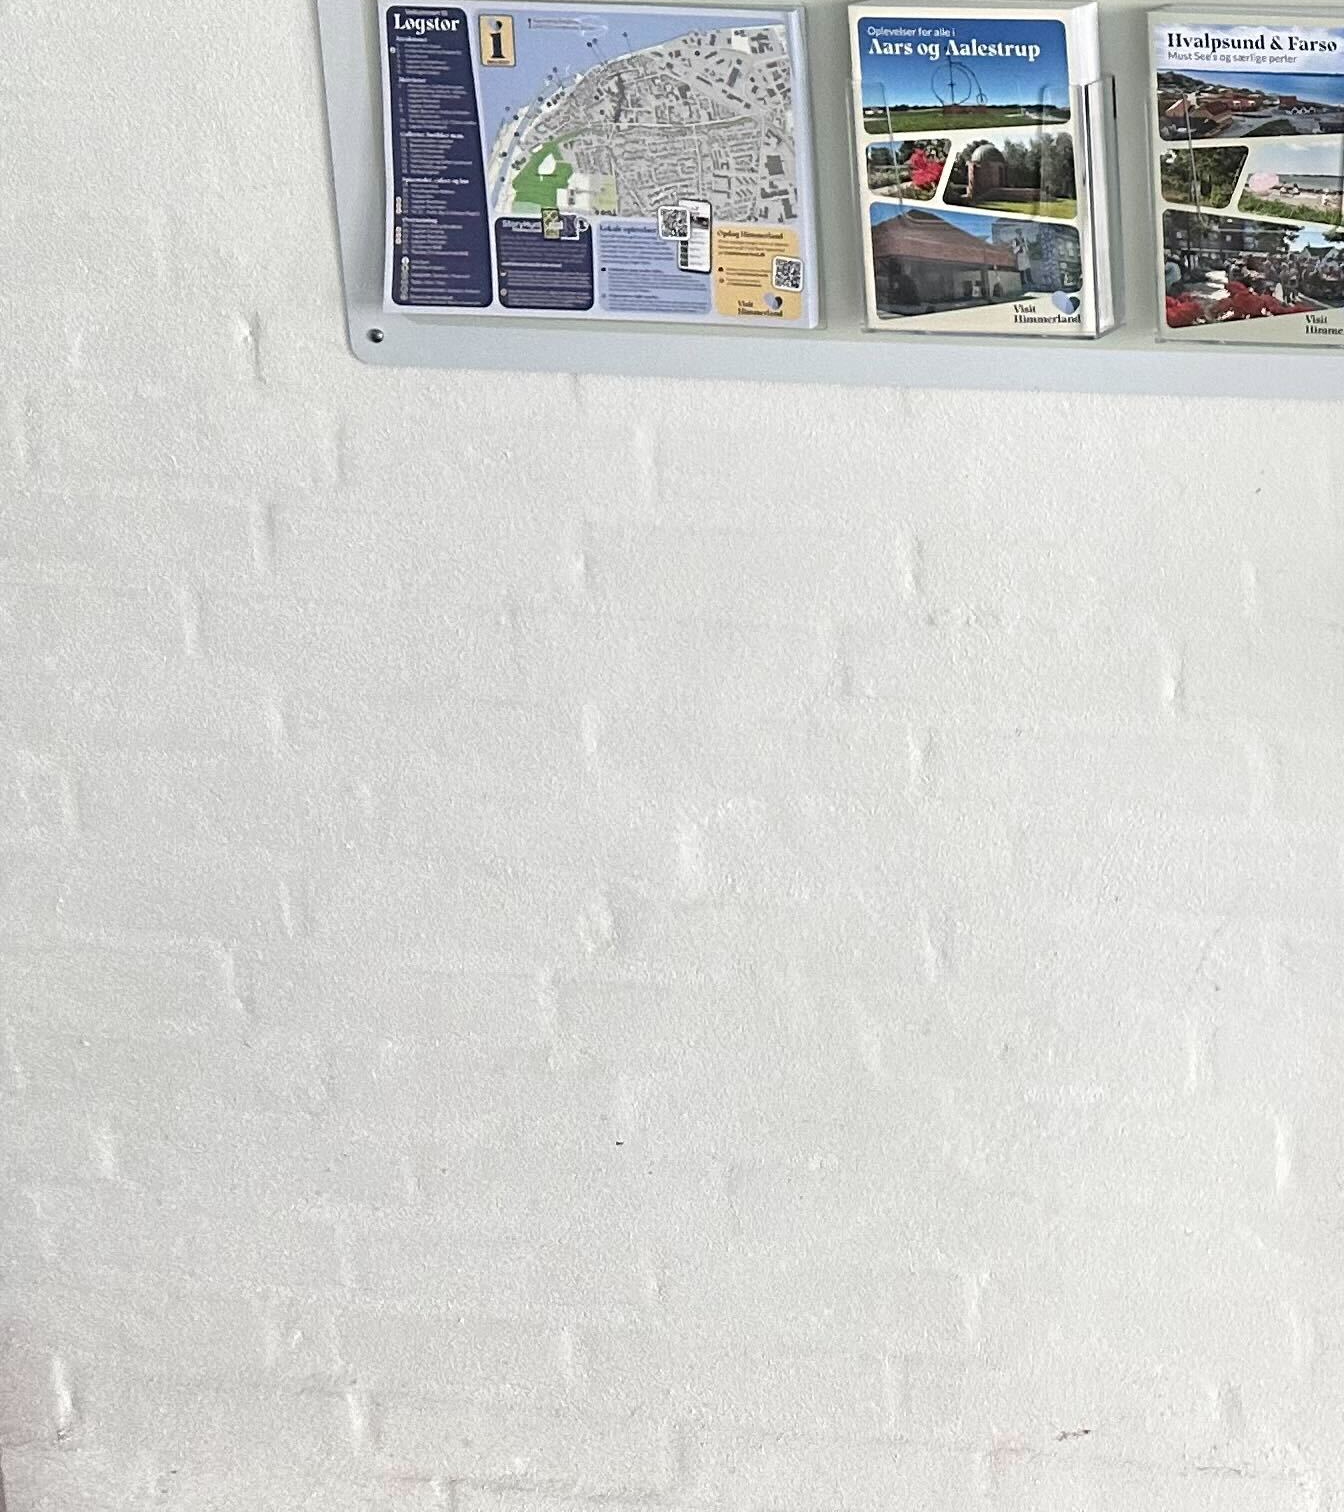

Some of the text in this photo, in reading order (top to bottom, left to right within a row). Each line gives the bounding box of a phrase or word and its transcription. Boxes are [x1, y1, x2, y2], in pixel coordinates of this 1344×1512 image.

[868, 38, 1040, 61] Aars og Aalestrup
[1167, 32, 1337, 52] Hvalpsund & Farsø
[1306, 315, 1328, 324] Visit
